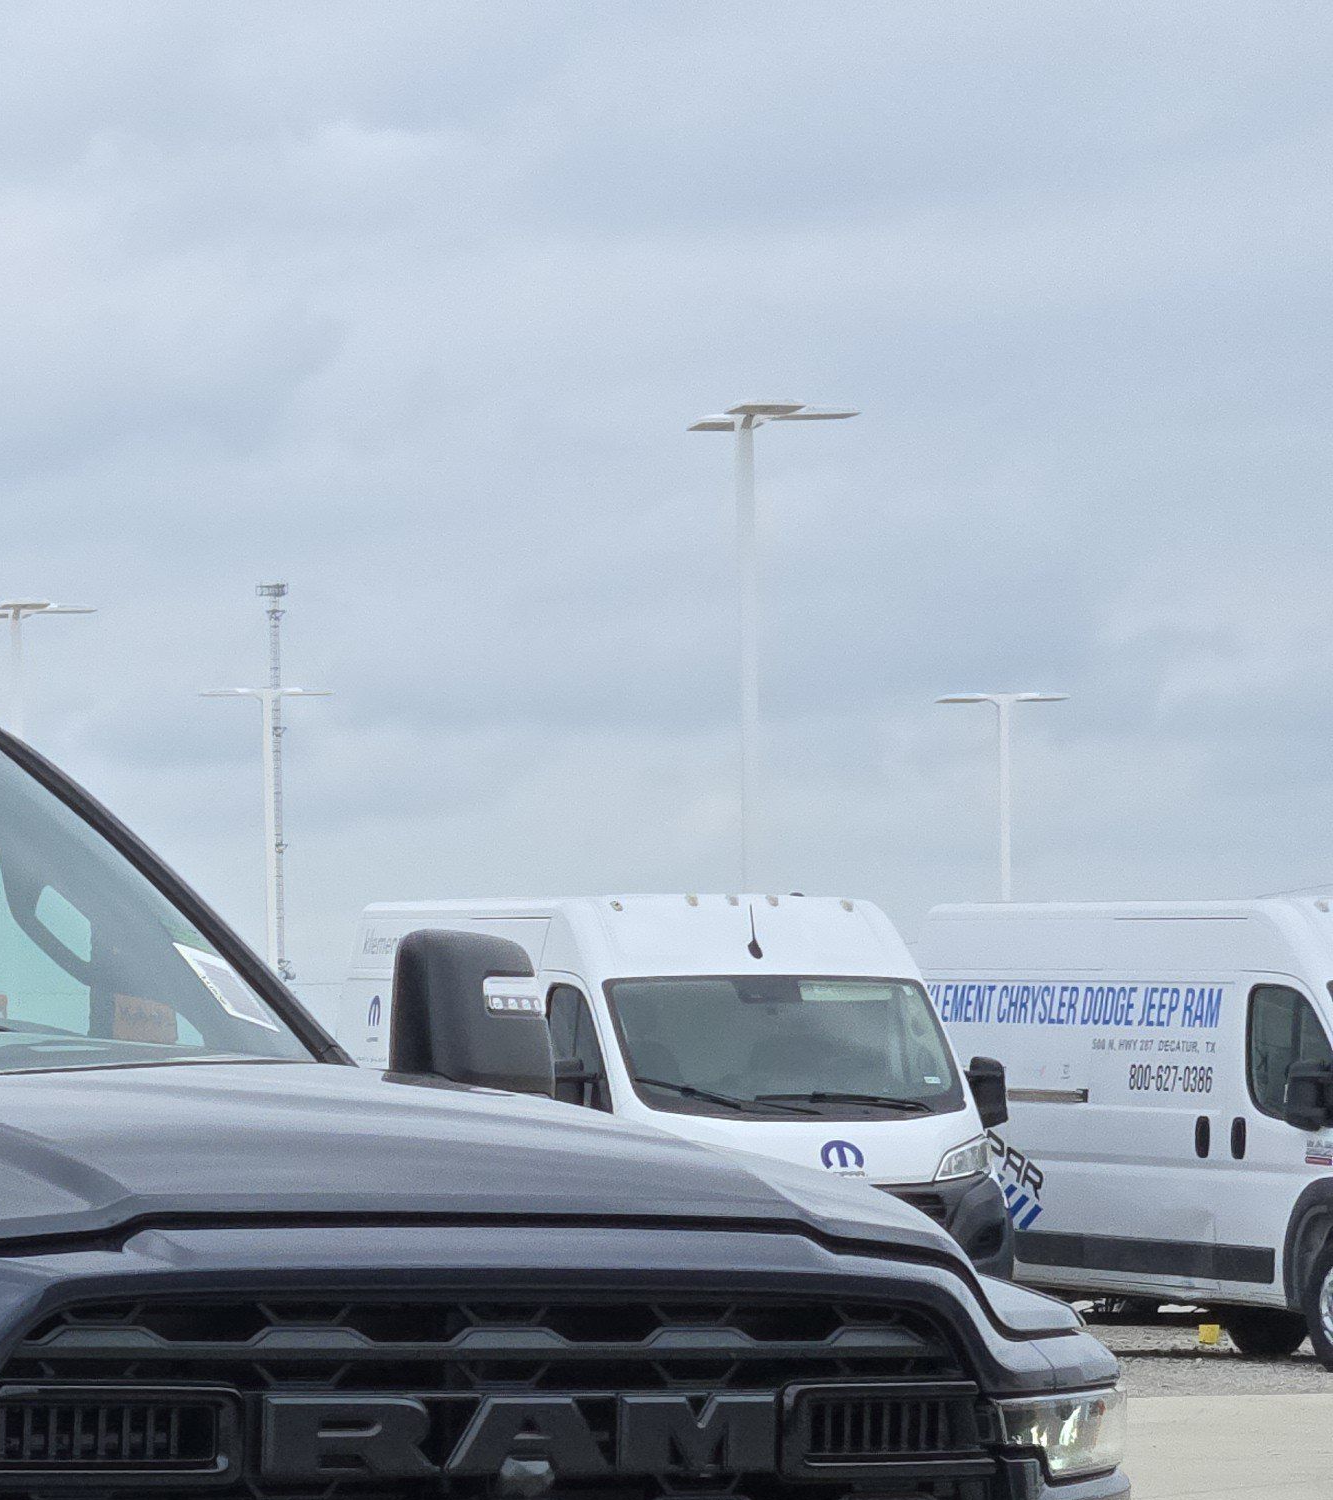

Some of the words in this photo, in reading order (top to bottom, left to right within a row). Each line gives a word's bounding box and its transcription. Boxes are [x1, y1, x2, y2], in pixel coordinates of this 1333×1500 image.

[996, 985, 1080, 1025] CHRYSLER
[1082, 986, 1138, 1026] DODGE
[1137, 987, 1184, 1027] JEEP
[1181, 988, 1223, 1028] RAM
[1118, 1039, 1138, 1051] HWY
[1205, 1041, 1216, 1053] TX
[1129, 1064, 1214, 1093] 800-627-0386
[261, 1394, 776, 1476] RAM
